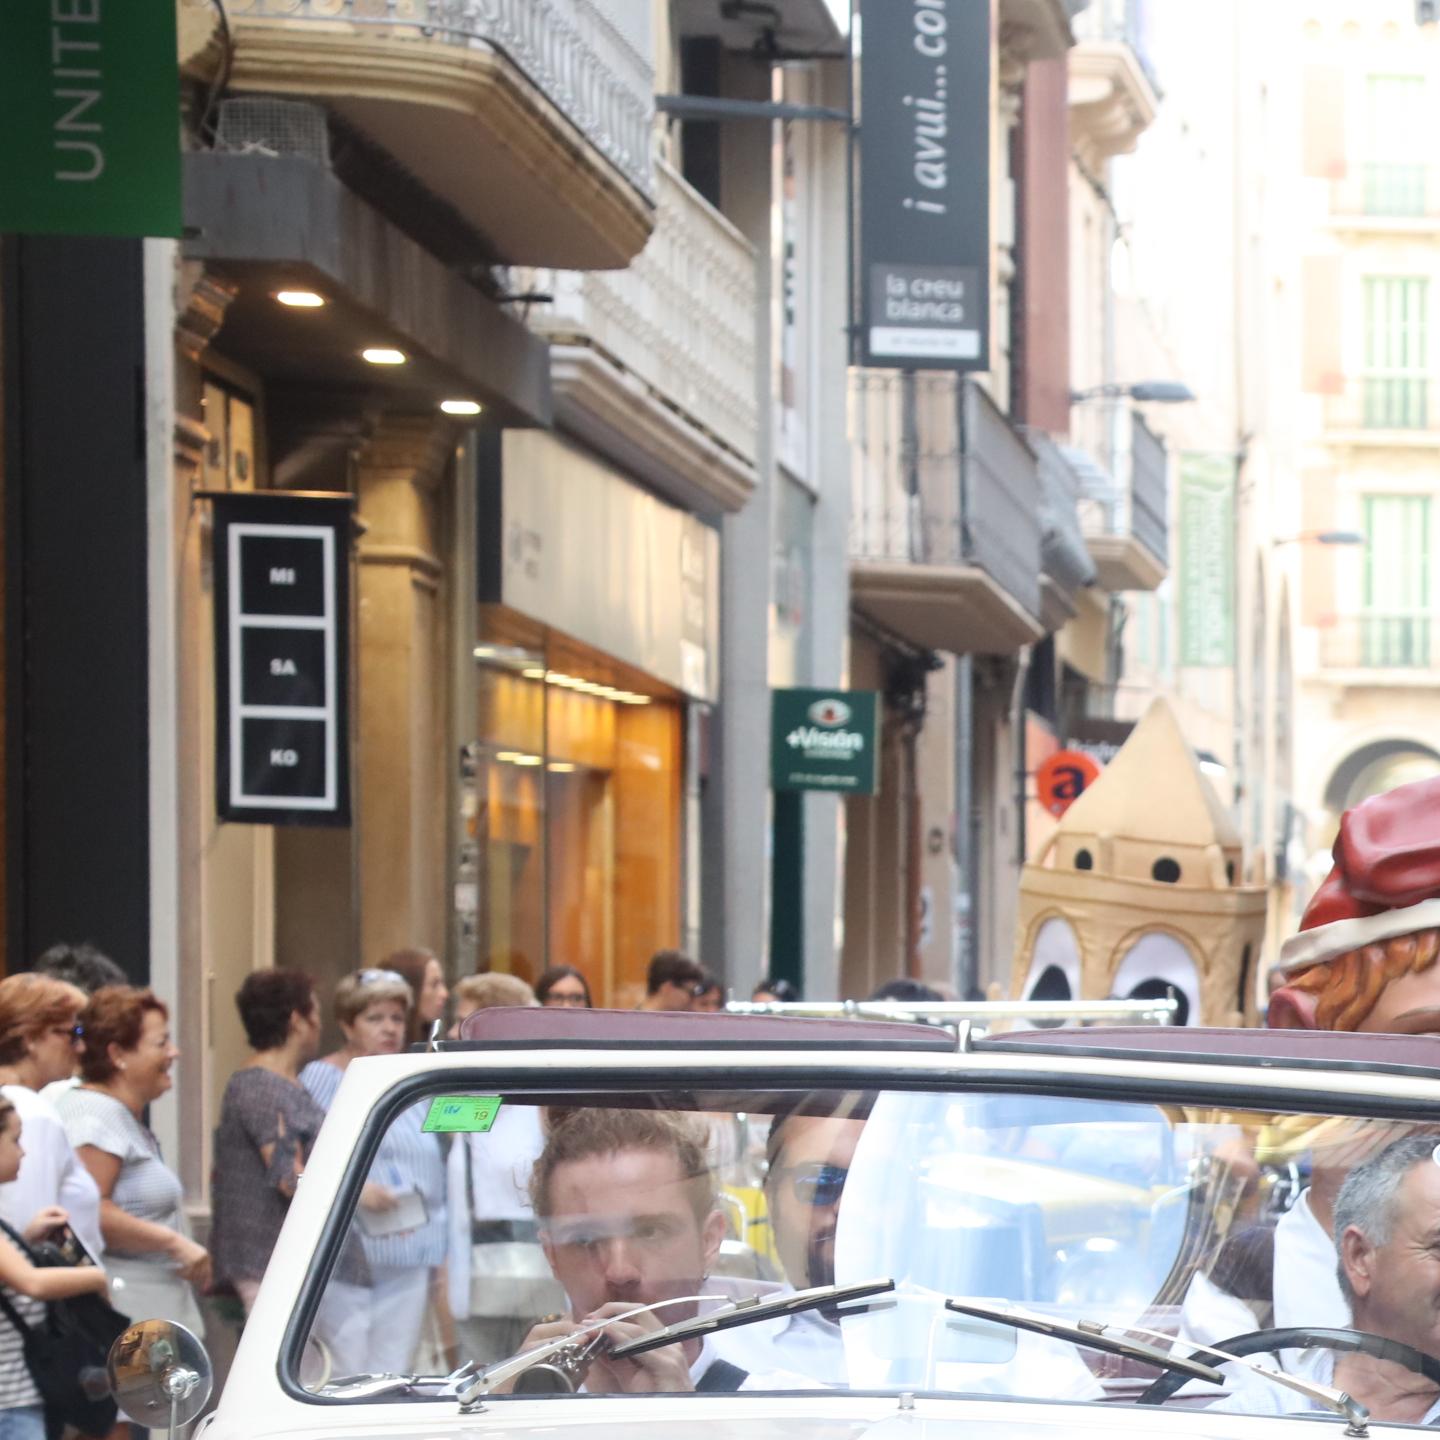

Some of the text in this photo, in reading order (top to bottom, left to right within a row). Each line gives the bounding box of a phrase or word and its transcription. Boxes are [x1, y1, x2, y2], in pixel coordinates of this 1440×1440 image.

[914, 0, 947, 57] co
[886, 273, 963, 299] la creu
[886, 297, 963, 321] blanca
[270, 568, 296, 585] MI
[270, 659, 297, 676] SA
